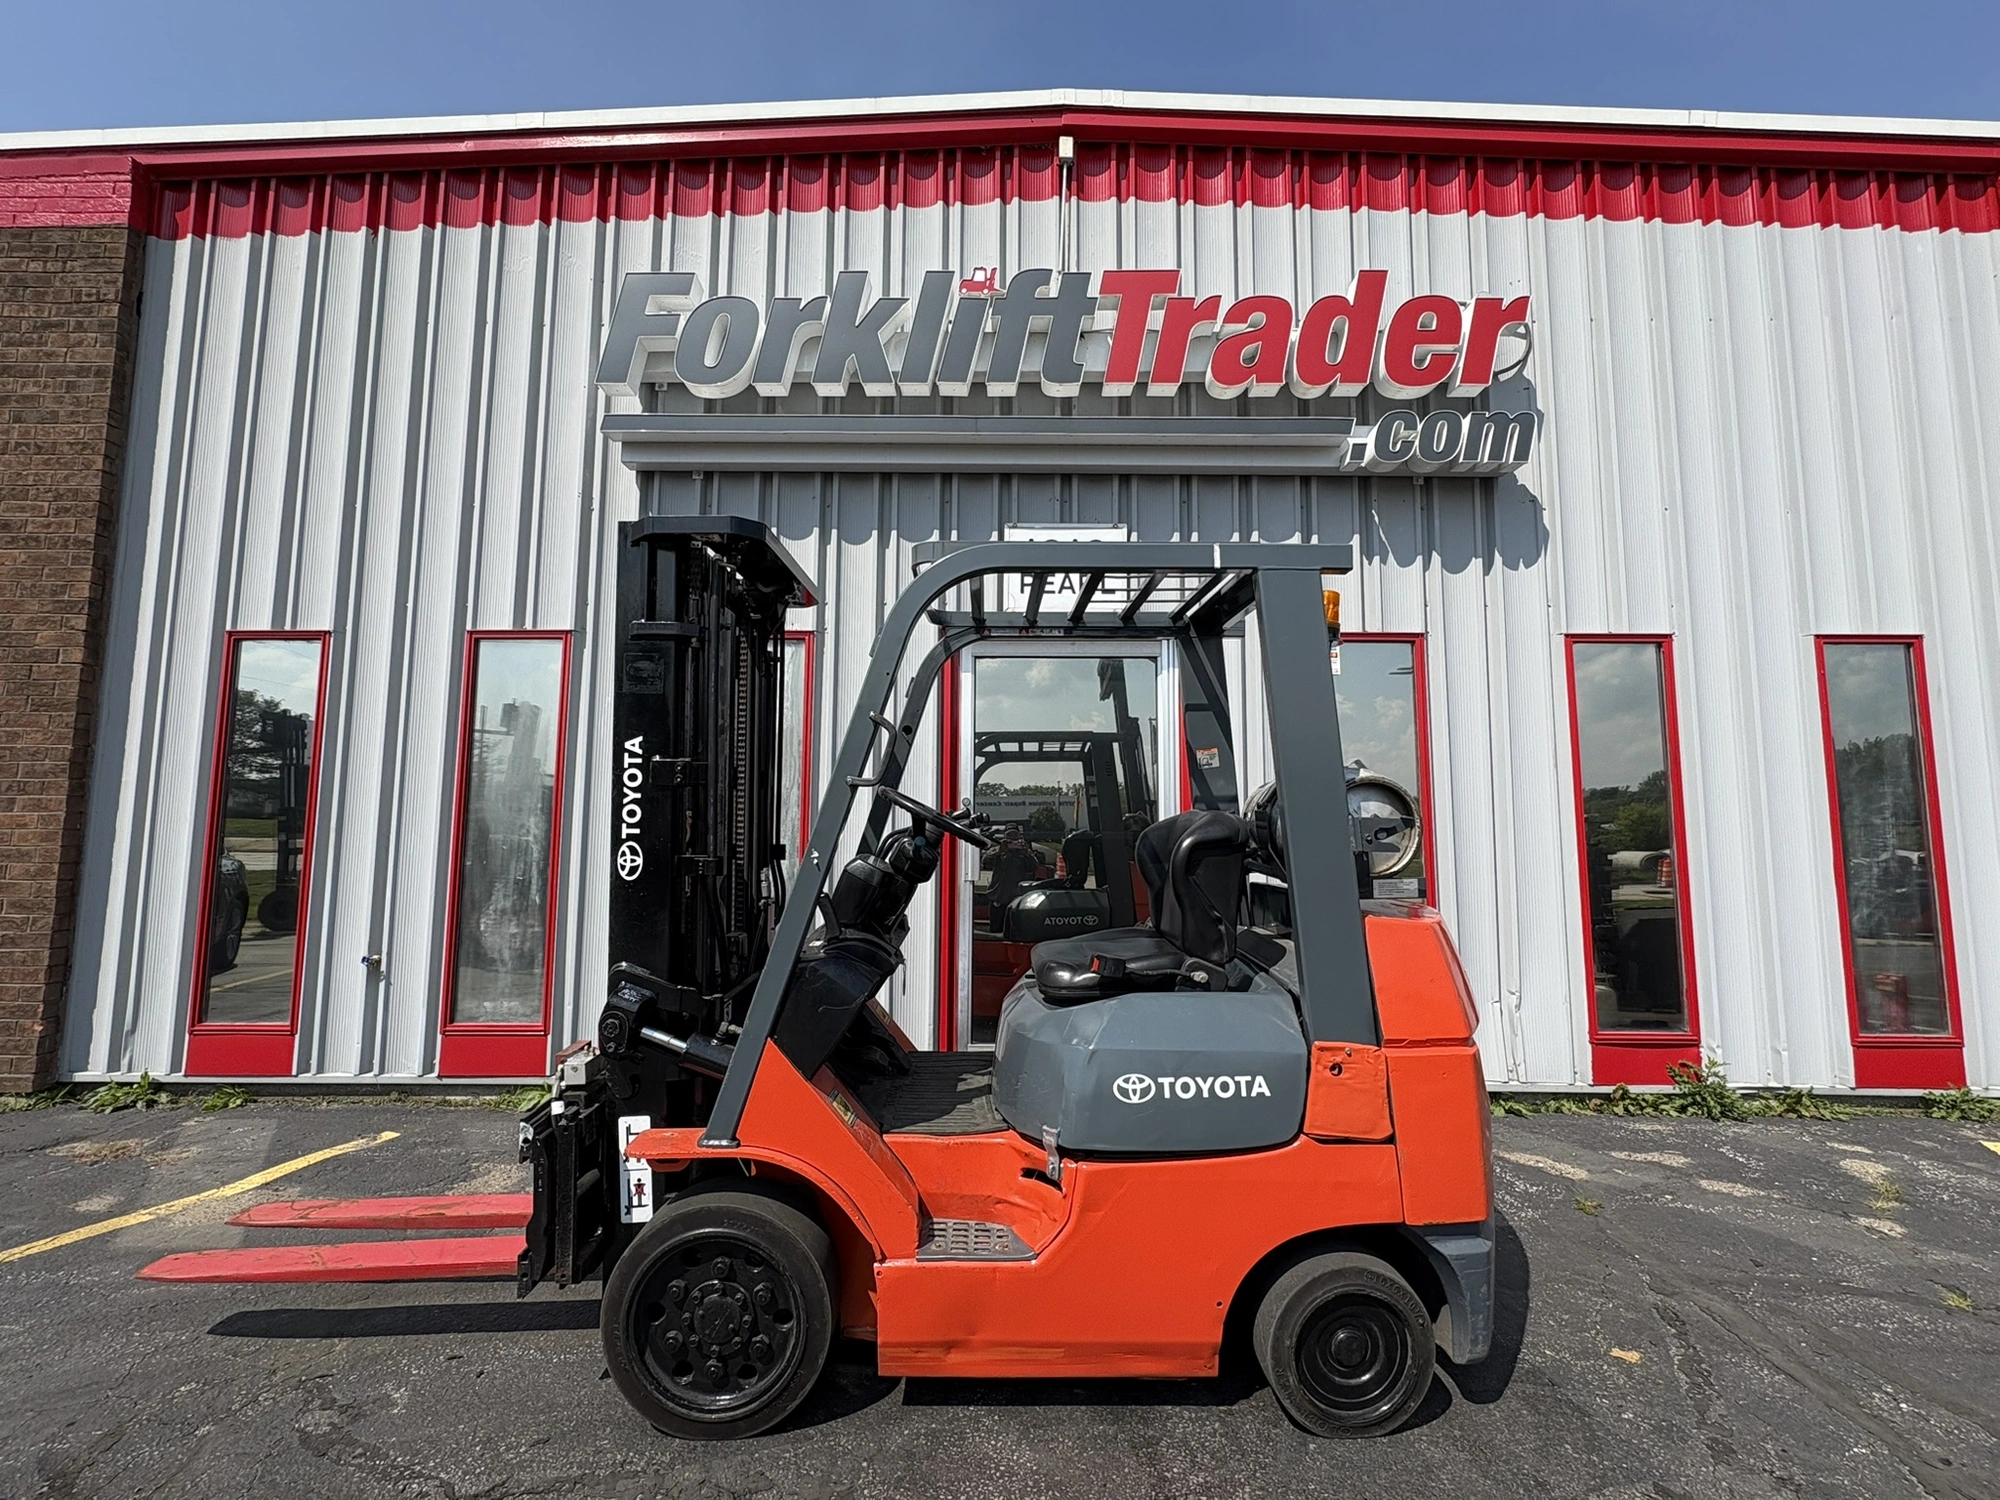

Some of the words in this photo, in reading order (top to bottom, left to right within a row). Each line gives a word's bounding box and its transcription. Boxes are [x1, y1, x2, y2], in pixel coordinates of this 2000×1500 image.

[1341, 409, 1538, 472] .com
[621, 735, 644, 839] TOYOTA
[1157, 1075, 1272, 1099] TOYOTA
